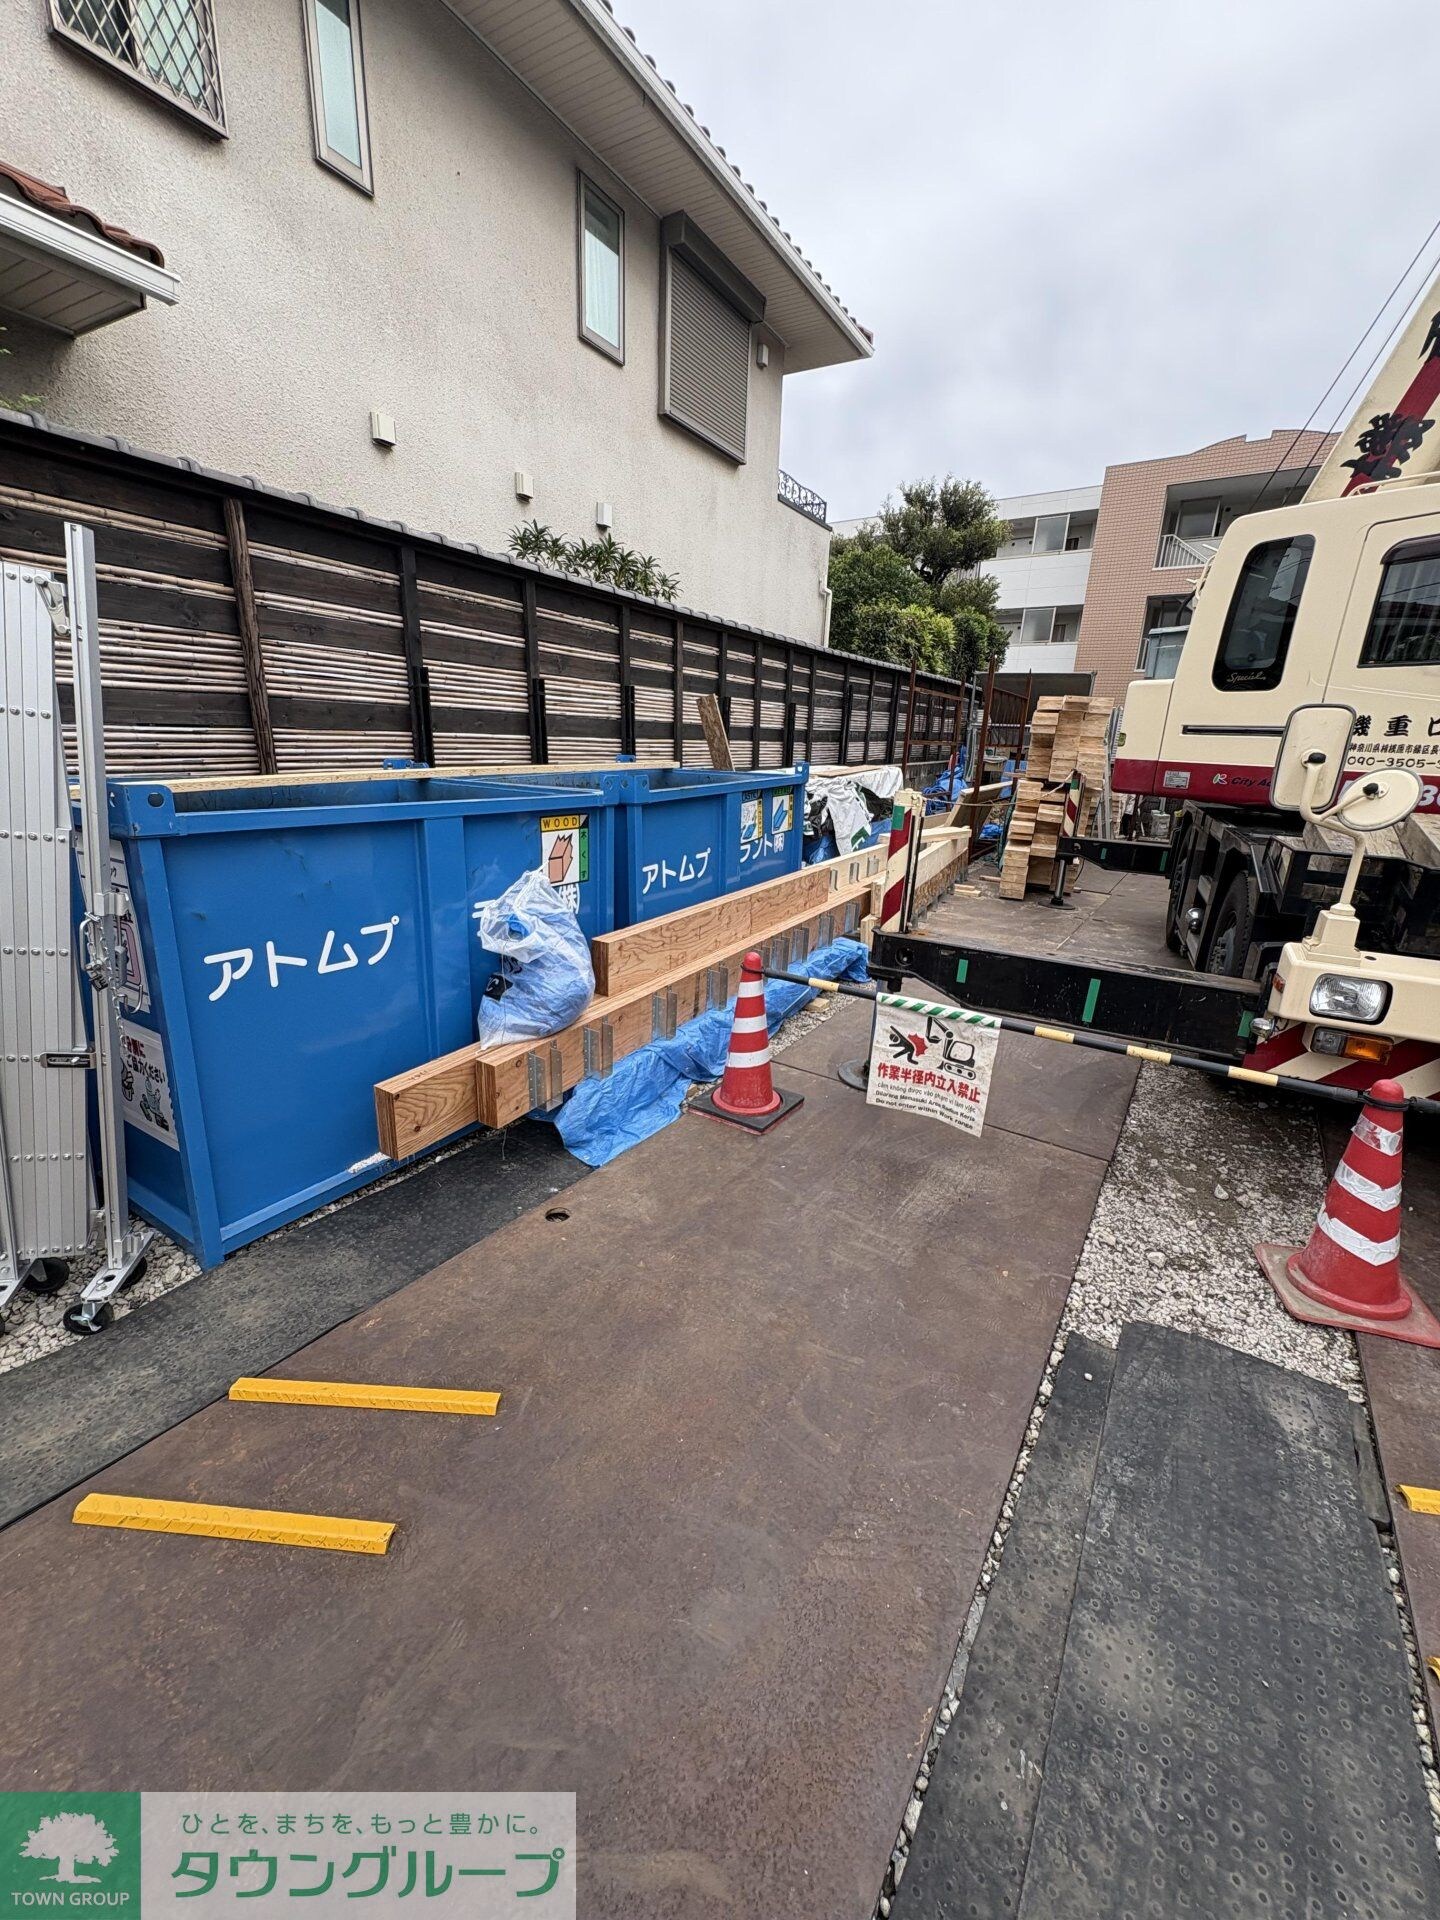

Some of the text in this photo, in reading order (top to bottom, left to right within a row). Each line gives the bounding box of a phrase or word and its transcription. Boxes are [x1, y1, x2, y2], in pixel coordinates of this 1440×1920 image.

[1349, 742, 1440, 755] 神奈川県相模原市緑区長
[542, 818, 578, 829] WOOD
[203, 915, 401, 1002] アトムプ
[877, 1062, 981, 1104] 作業半径内立入禁止
[886, 1099, 897, 1107] not
[918, 1105, 938, 1115] within
